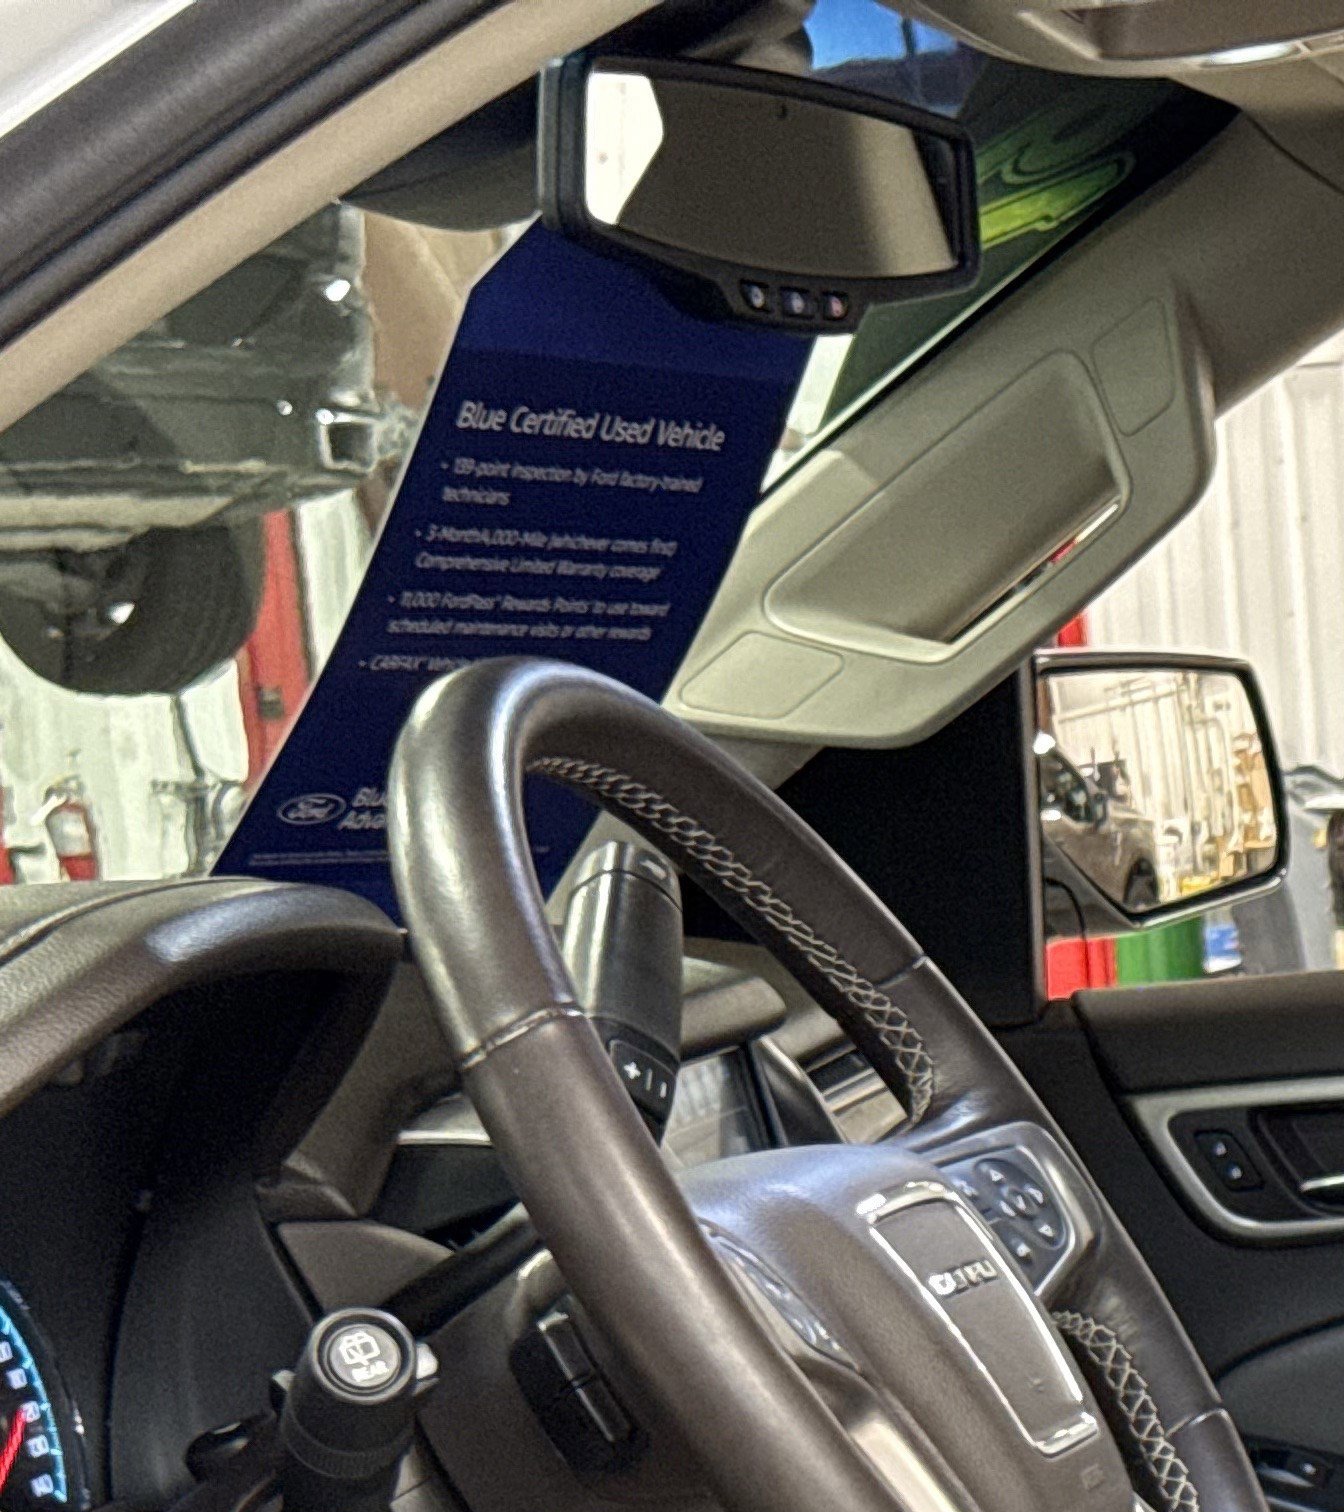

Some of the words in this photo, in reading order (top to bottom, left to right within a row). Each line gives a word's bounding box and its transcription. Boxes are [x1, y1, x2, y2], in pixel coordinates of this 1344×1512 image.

[456, 401, 507, 430] Blue
[510, 405, 599, 440] Certified
[600, 412, 656, 445] Used
[656, 419, 726, 451] Vehicle
[352, 786, 387, 808] Blu
